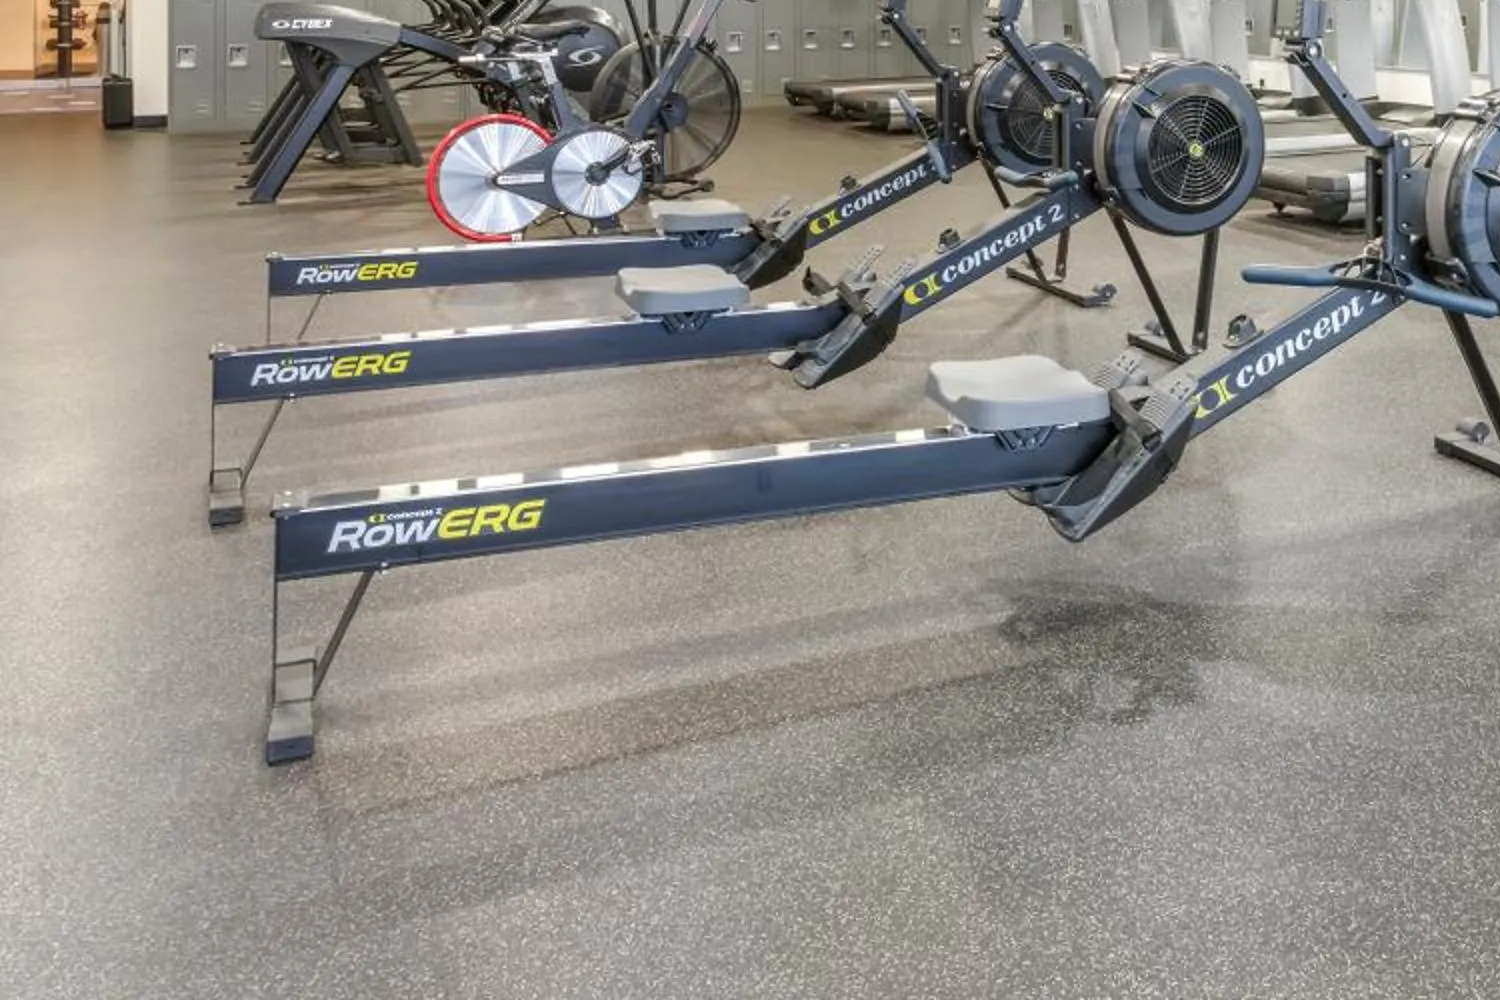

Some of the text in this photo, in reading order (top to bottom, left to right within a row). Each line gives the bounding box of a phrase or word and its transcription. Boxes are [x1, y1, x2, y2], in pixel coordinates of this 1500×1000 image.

[840, 164, 926, 219] concept
[941, 203, 1065, 284] concept 2
[1235, 294, 1365, 390] concept
